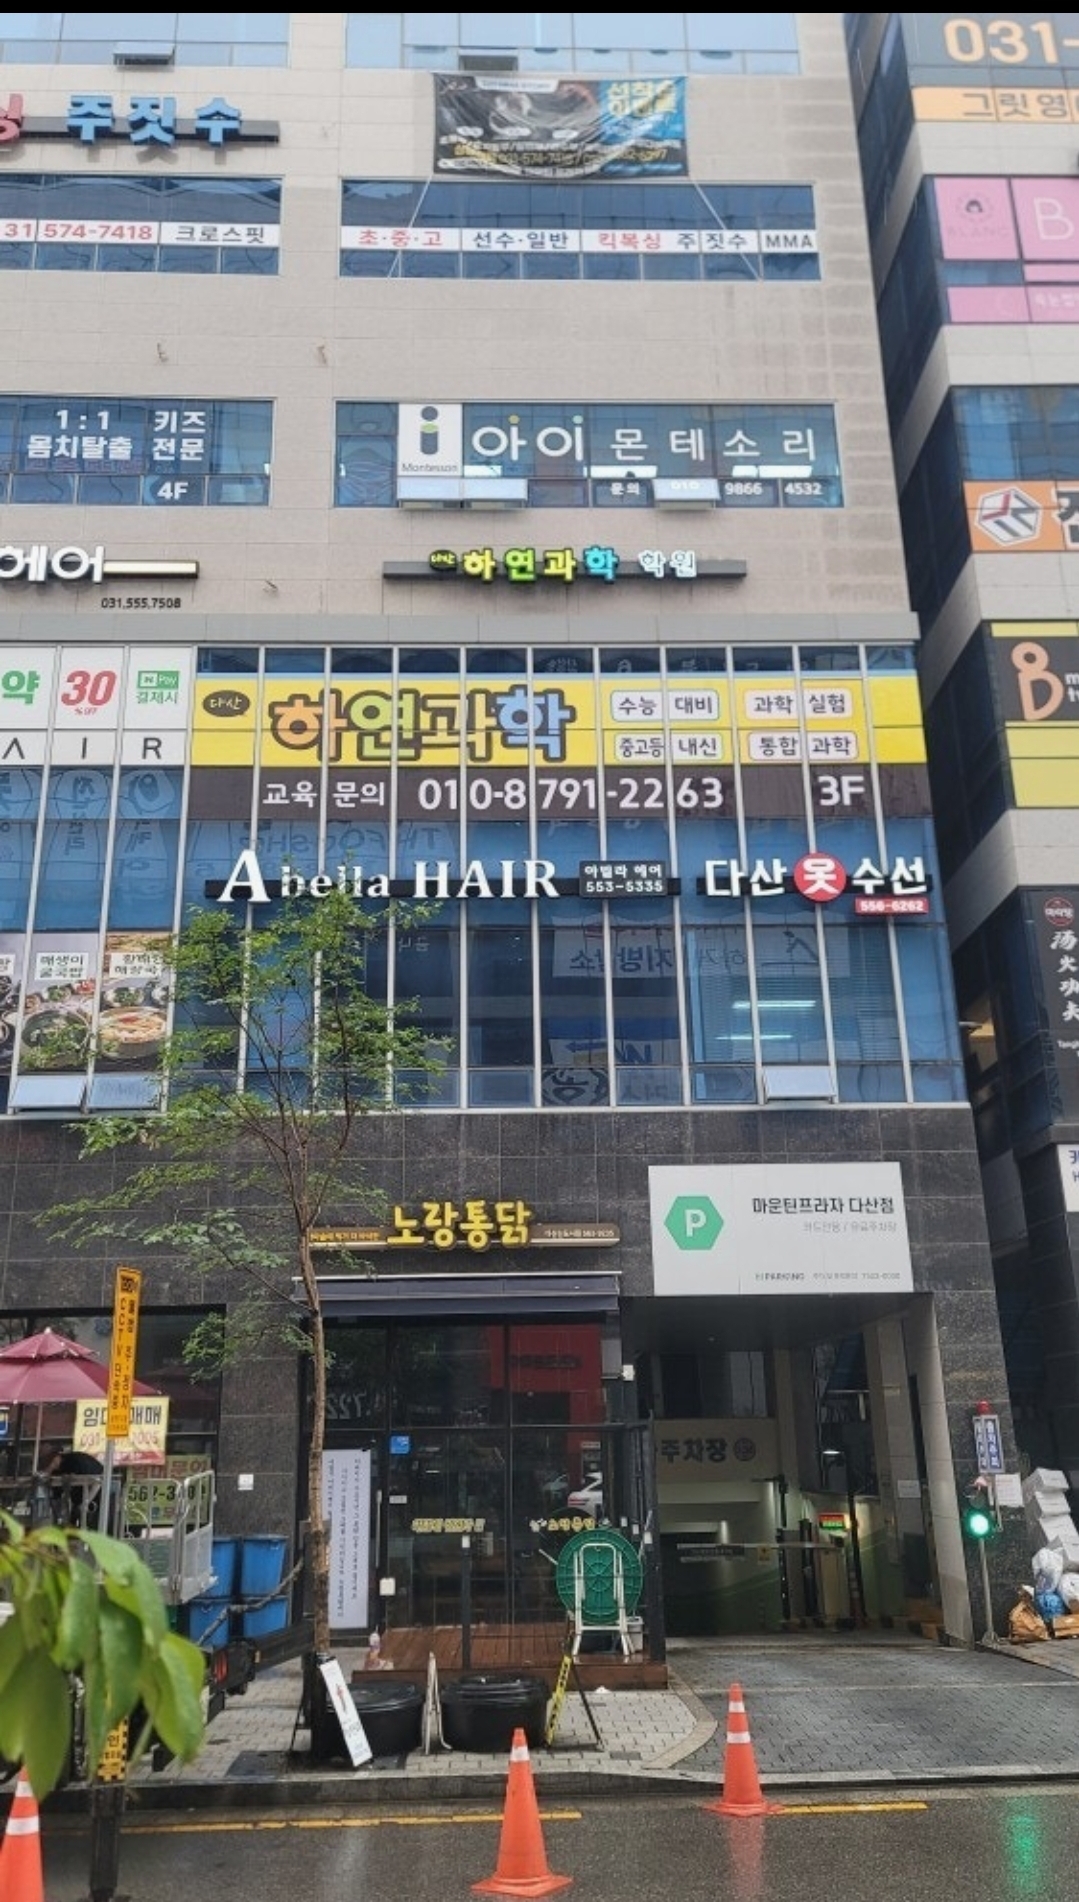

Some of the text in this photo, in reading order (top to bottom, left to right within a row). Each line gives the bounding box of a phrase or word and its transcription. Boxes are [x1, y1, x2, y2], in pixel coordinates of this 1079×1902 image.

[963, 92, 1079, 118] 그릿영
[67, 95, 241, 146] 주짓수
[4, 223, 266, 243] 31 574-7418 크로스핏
[472, 231, 568, 249] 선수·일반
[598, 232, 661, 249] 킥복싱
[678, 232, 747, 249] 주짓수
[765, 234, 814, 249] MMA
[56, 409, 207, 433] 1:1 키즈
[27, 435, 205, 462] 몸치탈출 전문
[157, 481, 188, 500] 4F
[610, 482, 640, 496] 문의
[724, 482, 763, 496] 9866
[784, 482, 822, 496] 4532
[0, 545, 105, 583] 헤어
[462, 545, 620, 584] 하연과학
[638, 549, 698, 579] 학원
[101, 597, 182, 610] 031.555.7508
[1, 670, 41, 705] 약
[61, 669, 117, 706] 30
[135, 691, 178, 705] 결제시
[618, 693, 713, 714] 수능 대비
[753, 693, 846, 714] 과학 실험
[269, 684, 577, 763] 하연과학
[618, 736, 717, 758] 중고등 내신
[758, 735, 852, 757] 통합 과학
[262, 775, 866, 811] 교육 문의 010-8791-2263 3F
[413, 859, 561, 899] HAIR
[586, 880, 663, 893] 553-5335
[705, 855, 927, 897] 다산 옷 수선
[39, 954, 84, 966] 매생이
[752, 1197, 896, 1215] 마운틴프라자 다산점
[386, 1199, 533, 1253] 노랑통닭
[684, 1208, 707, 1238] P
[654, 1437, 728, 1463] 주차장
